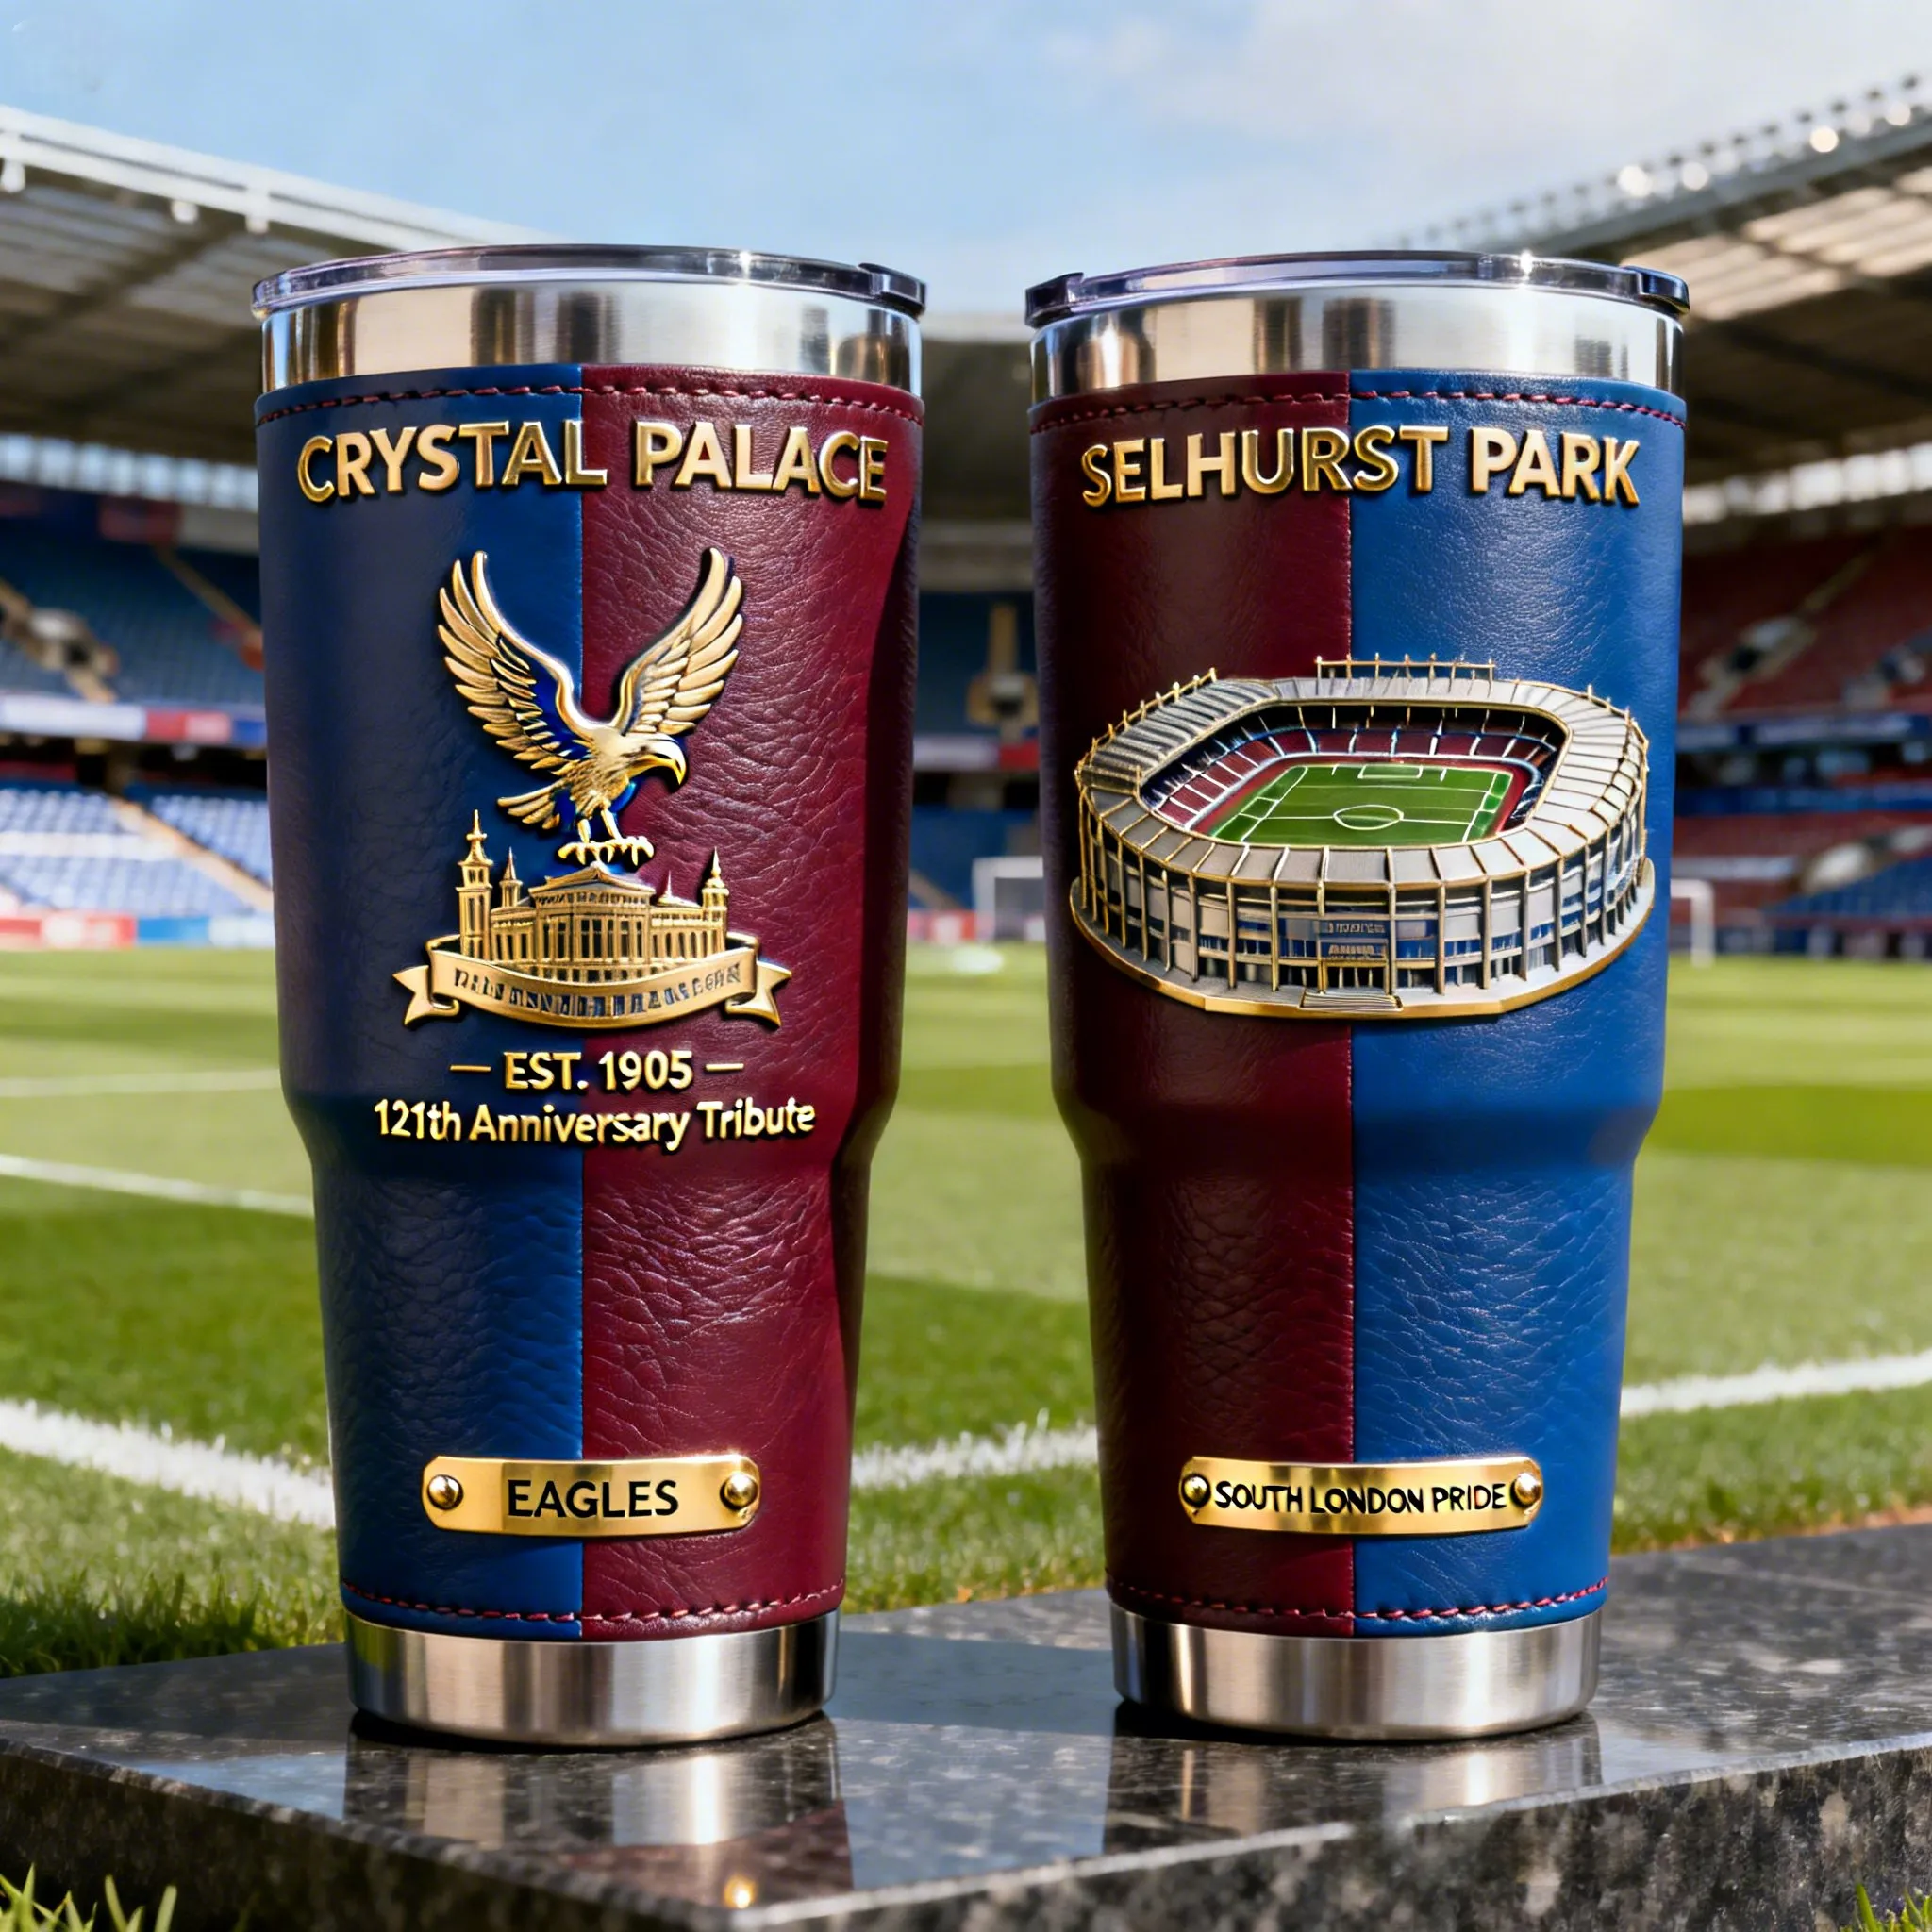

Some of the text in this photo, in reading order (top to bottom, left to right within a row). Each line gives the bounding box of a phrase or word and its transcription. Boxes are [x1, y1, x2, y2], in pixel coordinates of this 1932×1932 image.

[297, 420, 889, 502] CRYSTAL PALACE
[1081, 425, 1641, 507] SELHURST PARK
[503, 1050, 693, 1091] EST. 1905
[374, 1097, 816, 1153] 121th Anniversary Tribute
[508, 1479, 679, 1519] EAGLES
[1214, 1480, 1507, 1515] SOUTH LONDON PRIDE
